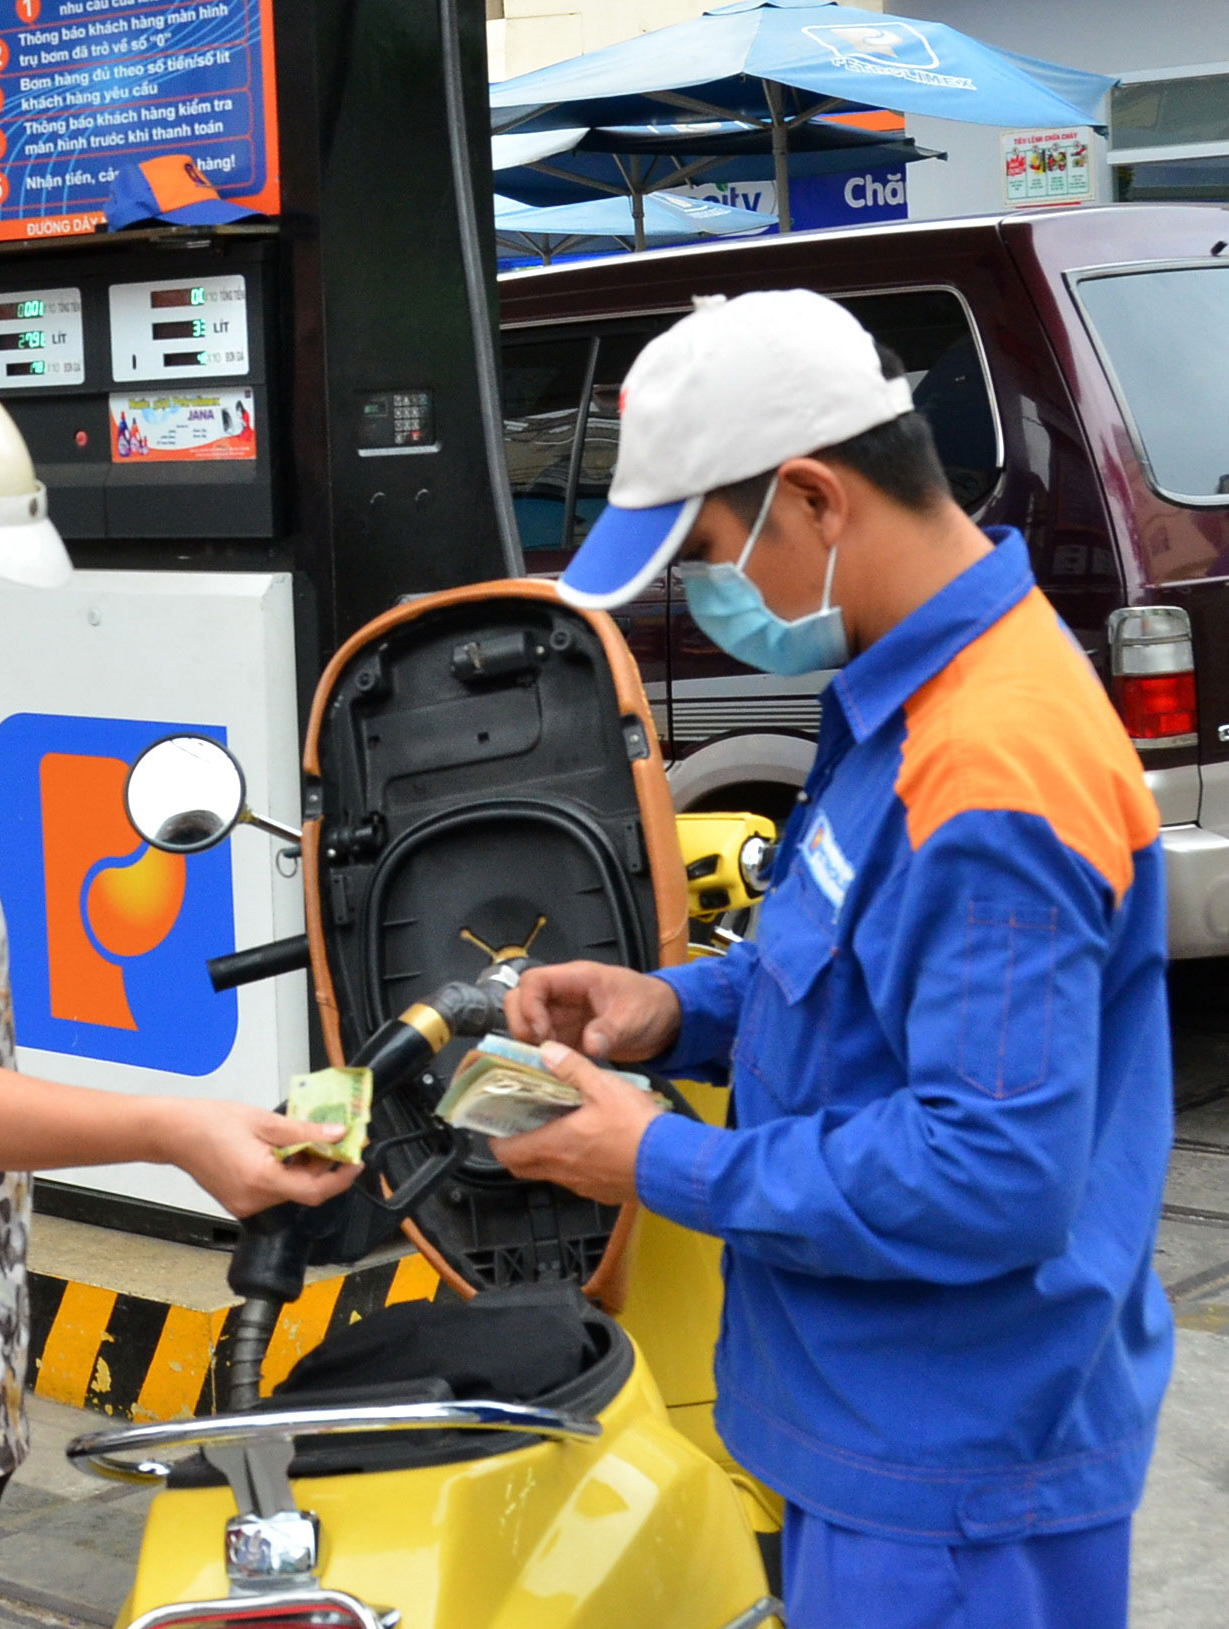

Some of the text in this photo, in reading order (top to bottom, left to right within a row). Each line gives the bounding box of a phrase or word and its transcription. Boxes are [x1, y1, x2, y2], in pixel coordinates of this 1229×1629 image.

[22, 0, 32, 17] 1
[59, 2, 84, 16] nhu
[18, 3, 228, 46] Thông báo khách hàng màn hình
[19, 54, 38, 68] trụ
[40, 50, 69, 63] bơm
[72, 45, 88, 59] đã
[91, 40, 109, 56] trở
[131, 34, 148, 50] số
[20, 77, 51, 91] Bơm
[54, 72, 89, 86] hàng
[92, 66, 110, 81] đủ
[113, 64, 144, 78] theo
[147, 57, 164, 73] số
[830, 56, 978, 90] PETROLIMEX
[21, 94, 63, 110] khách
[66, 91, 101, 104] hàng
[104, 85, 129, 103] yêu
[23, 98, 233, 134] Thông báo khách hàng kiểm tra
[25, 119, 224, 155] màn hình trước khi thanh toán
[26, 174, 62, 190] Nhận
[98, 167, 119, 182] cả
[196, 153, 236, 172] hàng!
[26, 218, 70, 236] ĐƯỜNG
[51, 331, 66, 344] LÍT
[213, 319, 229, 333] LÍT
[188, 409, 215, 421] JANA
